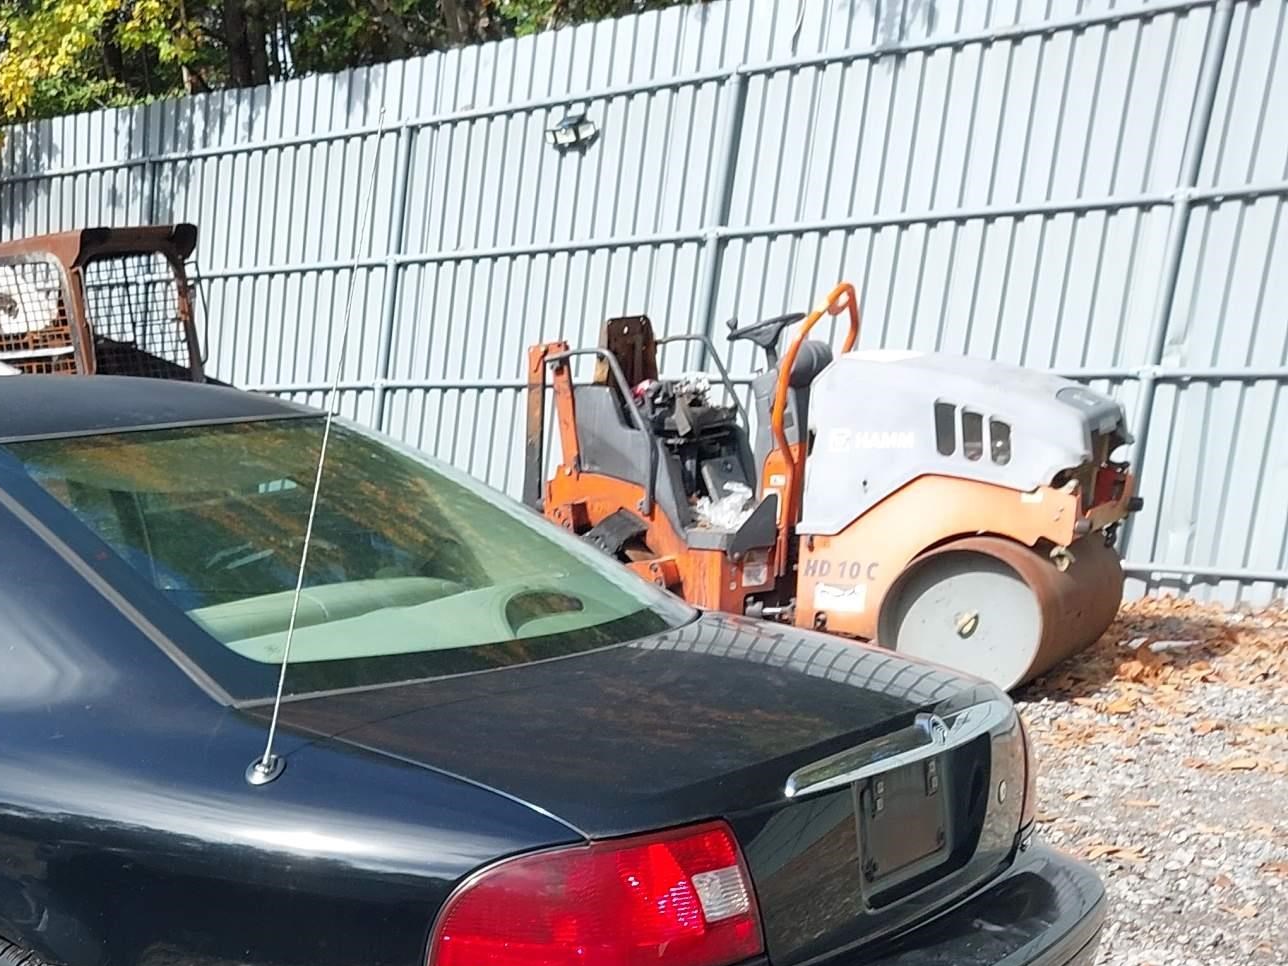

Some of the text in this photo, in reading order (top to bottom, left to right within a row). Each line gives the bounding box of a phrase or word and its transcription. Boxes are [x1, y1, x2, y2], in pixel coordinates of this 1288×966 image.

[803, 559, 880, 580] HD 10 C
